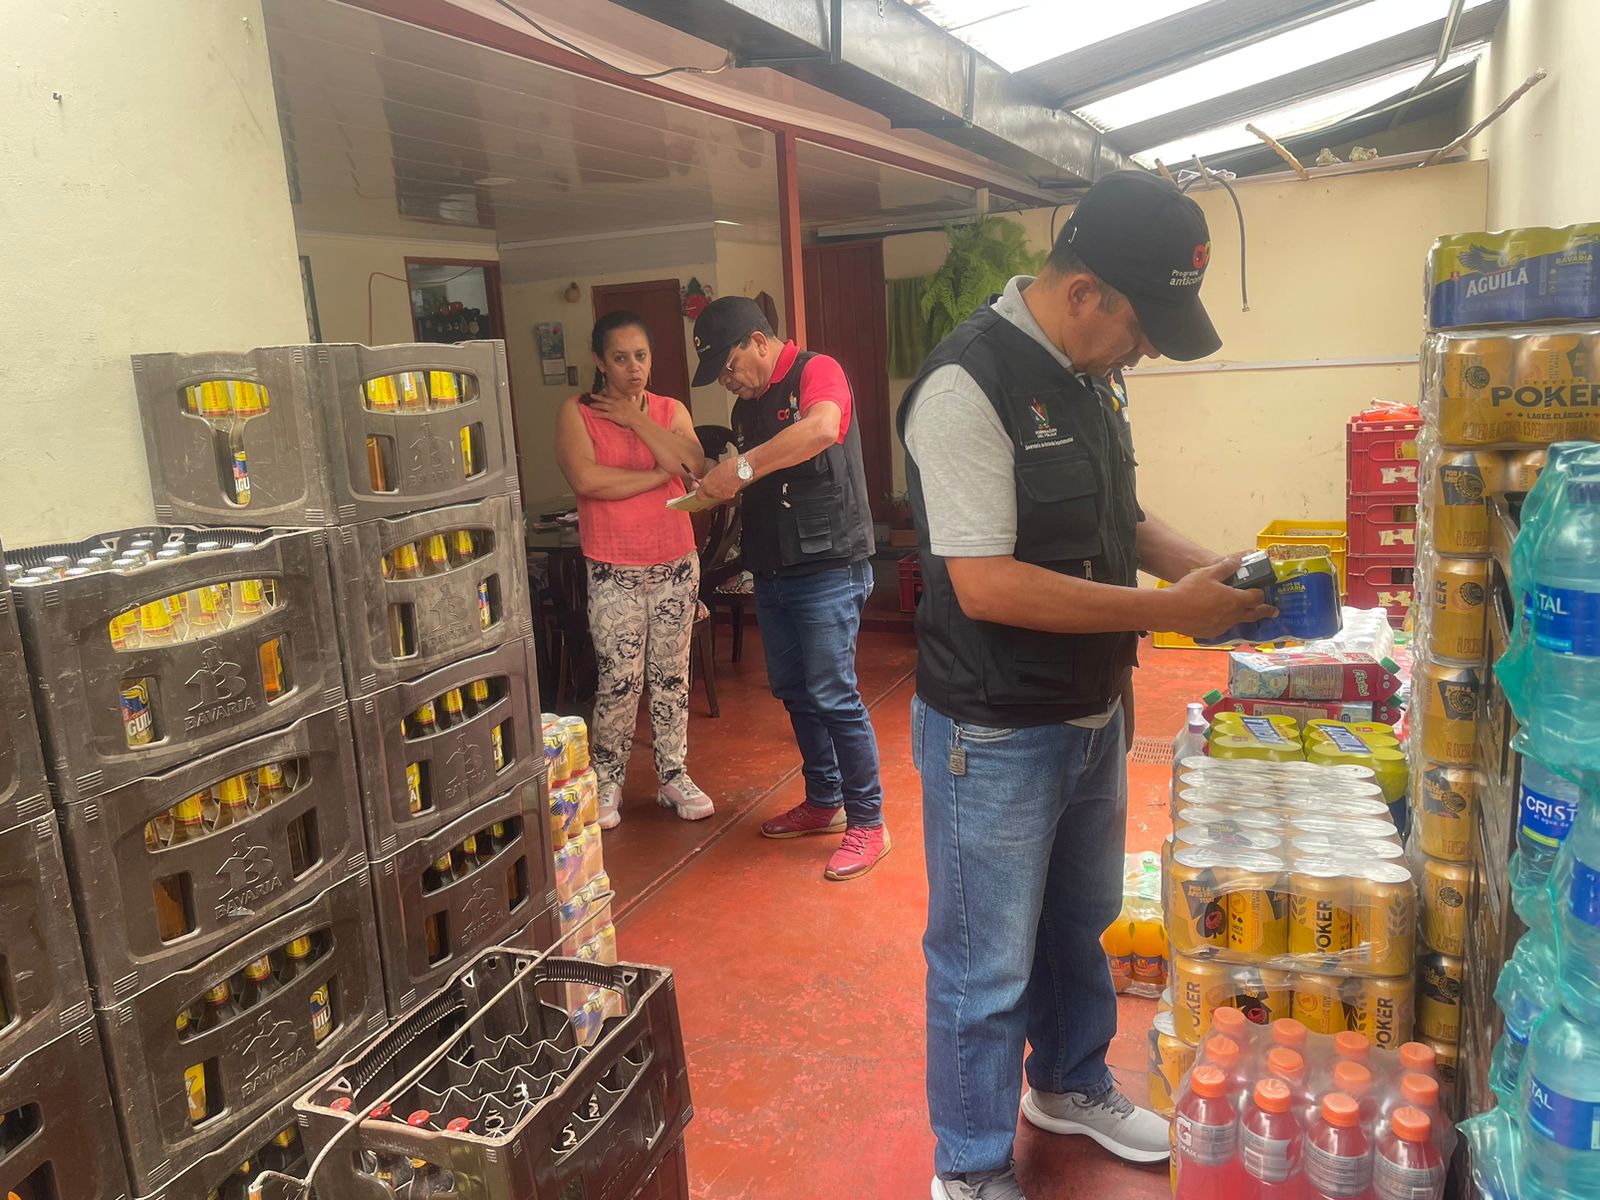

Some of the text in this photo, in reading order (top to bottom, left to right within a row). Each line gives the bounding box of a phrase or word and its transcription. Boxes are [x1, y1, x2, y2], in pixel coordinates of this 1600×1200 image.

[1536, 591, 1569, 615] TAL
[184, 696, 257, 731] BAVARIA
[1526, 796, 1578, 822] CRIST
[1531, 1080, 1556, 1112] TAL
